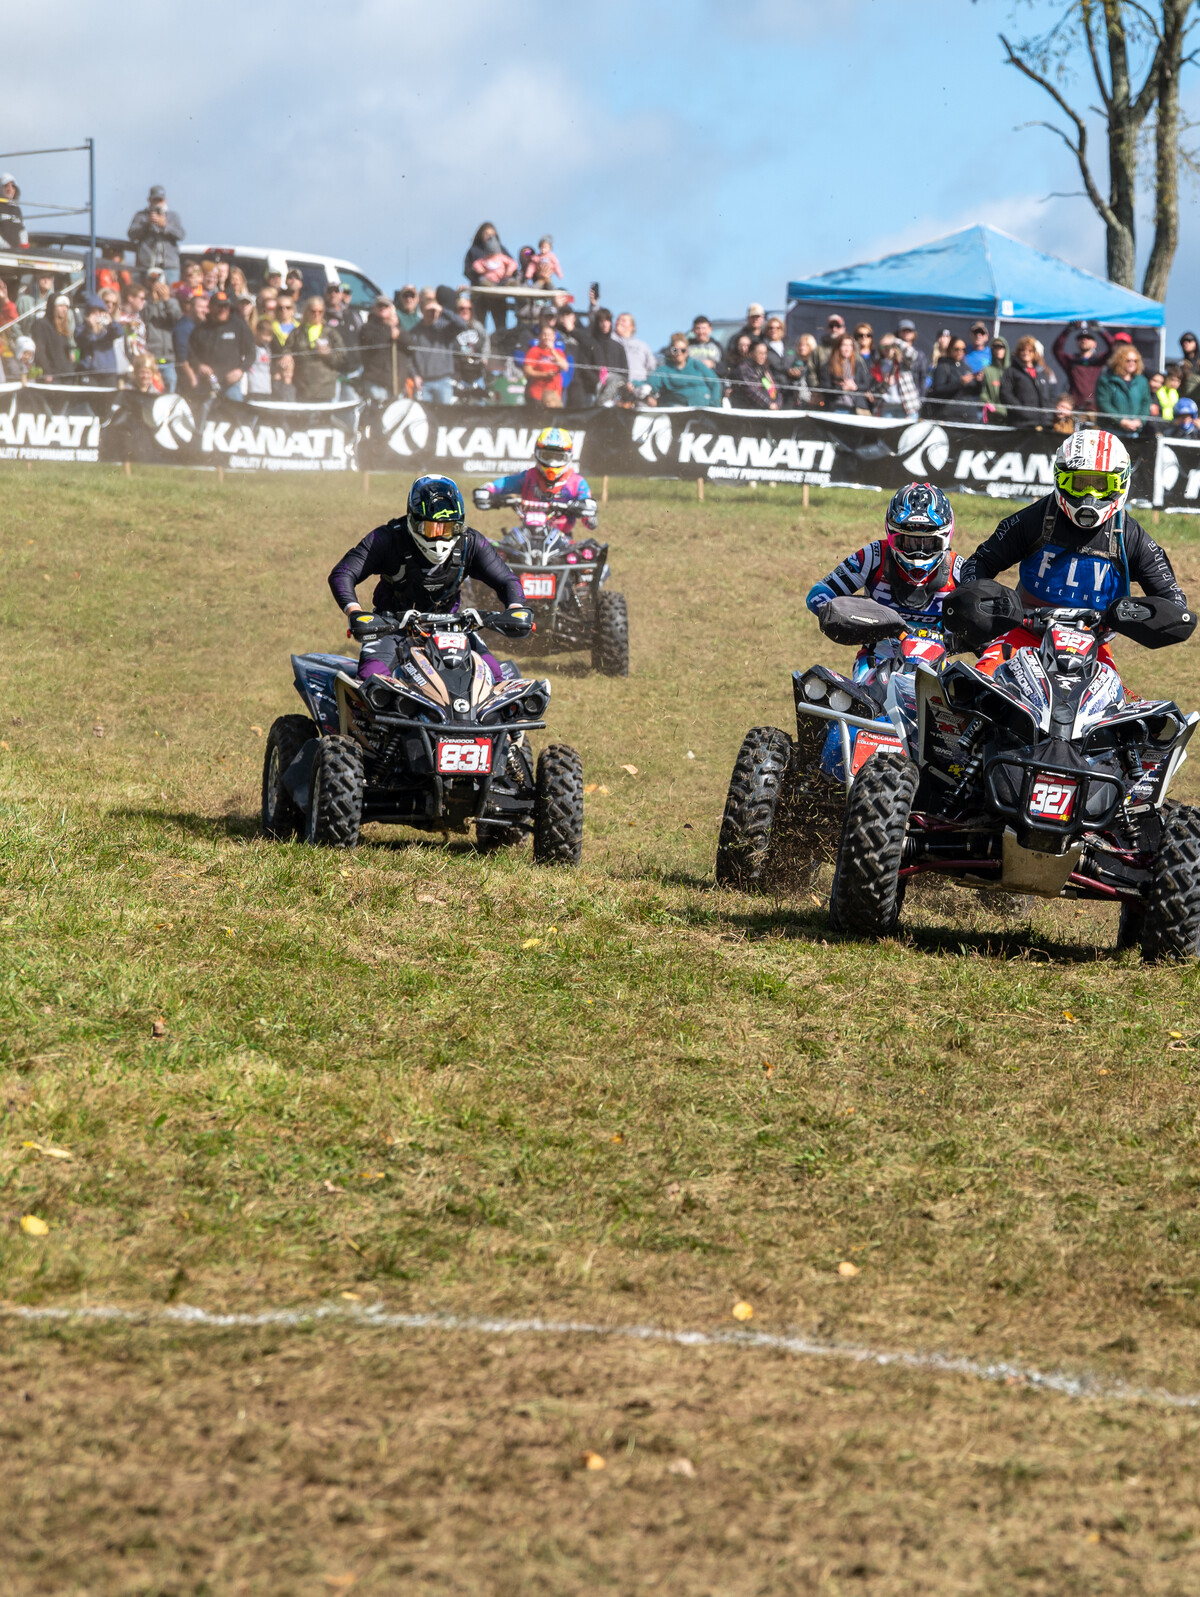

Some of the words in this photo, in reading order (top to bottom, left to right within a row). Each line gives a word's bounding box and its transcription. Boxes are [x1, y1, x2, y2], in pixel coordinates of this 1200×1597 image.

[0, 412, 100, 447] ANATI
[202, 421, 347, 458] KANATI
[435, 426, 586, 460] KANI
[678, 432, 836, 471] KANATI
[954, 449, 1056, 483] KAN
[1037, 550, 1111, 591] FLY
[522, 580, 554, 596] 510
[1034, 581, 1101, 603] RACING
[909, 641, 932, 656] 1
[1055, 632, 1093, 651] 327
[404, 662, 428, 687] can-am
[440, 744, 490, 771] 831
[1029, 783, 1077, 815] 327
